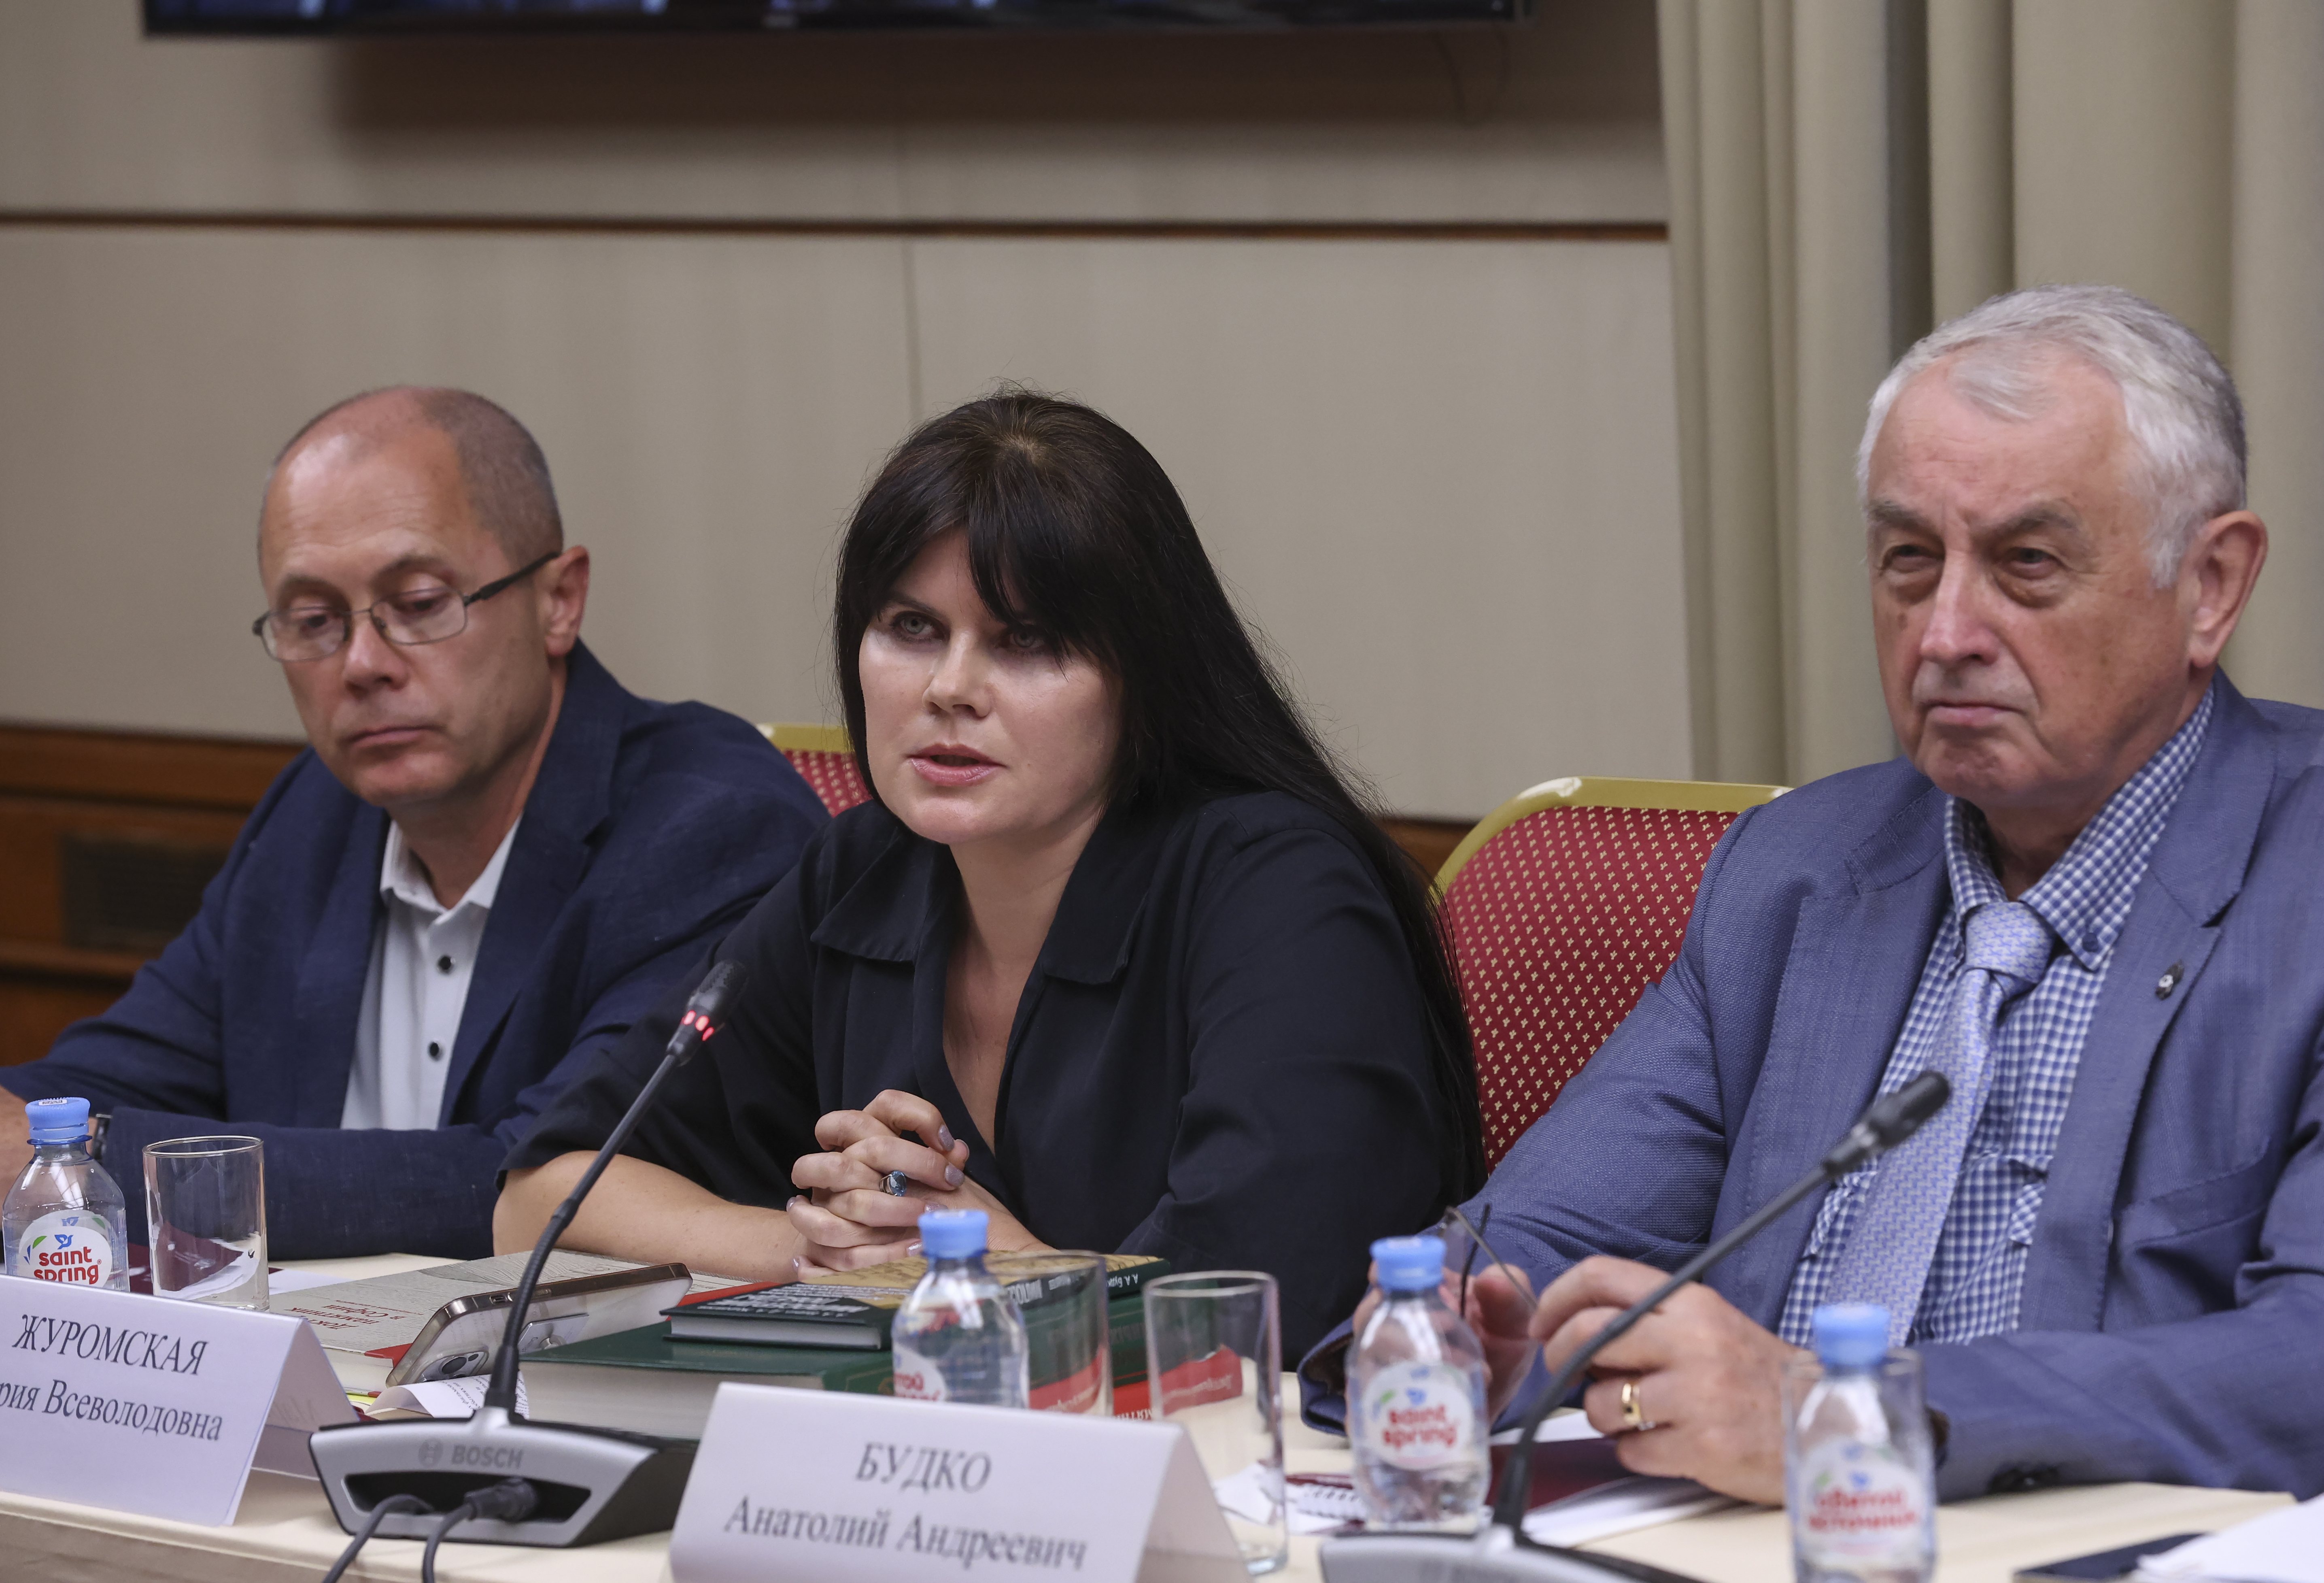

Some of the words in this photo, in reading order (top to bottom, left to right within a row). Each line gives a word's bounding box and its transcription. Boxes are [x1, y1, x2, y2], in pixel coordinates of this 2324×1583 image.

[39, 1246, 92, 1266] saint
[34, 1264, 99, 1285] spring
[1106, 1275, 1123, 1288] Будк
[284, 1307, 381, 1324] памятник
[12, 1314, 210, 1376] ЖУРОМСКАЯ
[42, 1379, 223, 1441] Всеволодовна
[450, 1443, 524, 1469] BOSCH
[855, 1442, 993, 1495] БУДКО
[723, 1495, 892, 1549] Анатолий
[896, 1513, 1089, 1571] Андреевич
